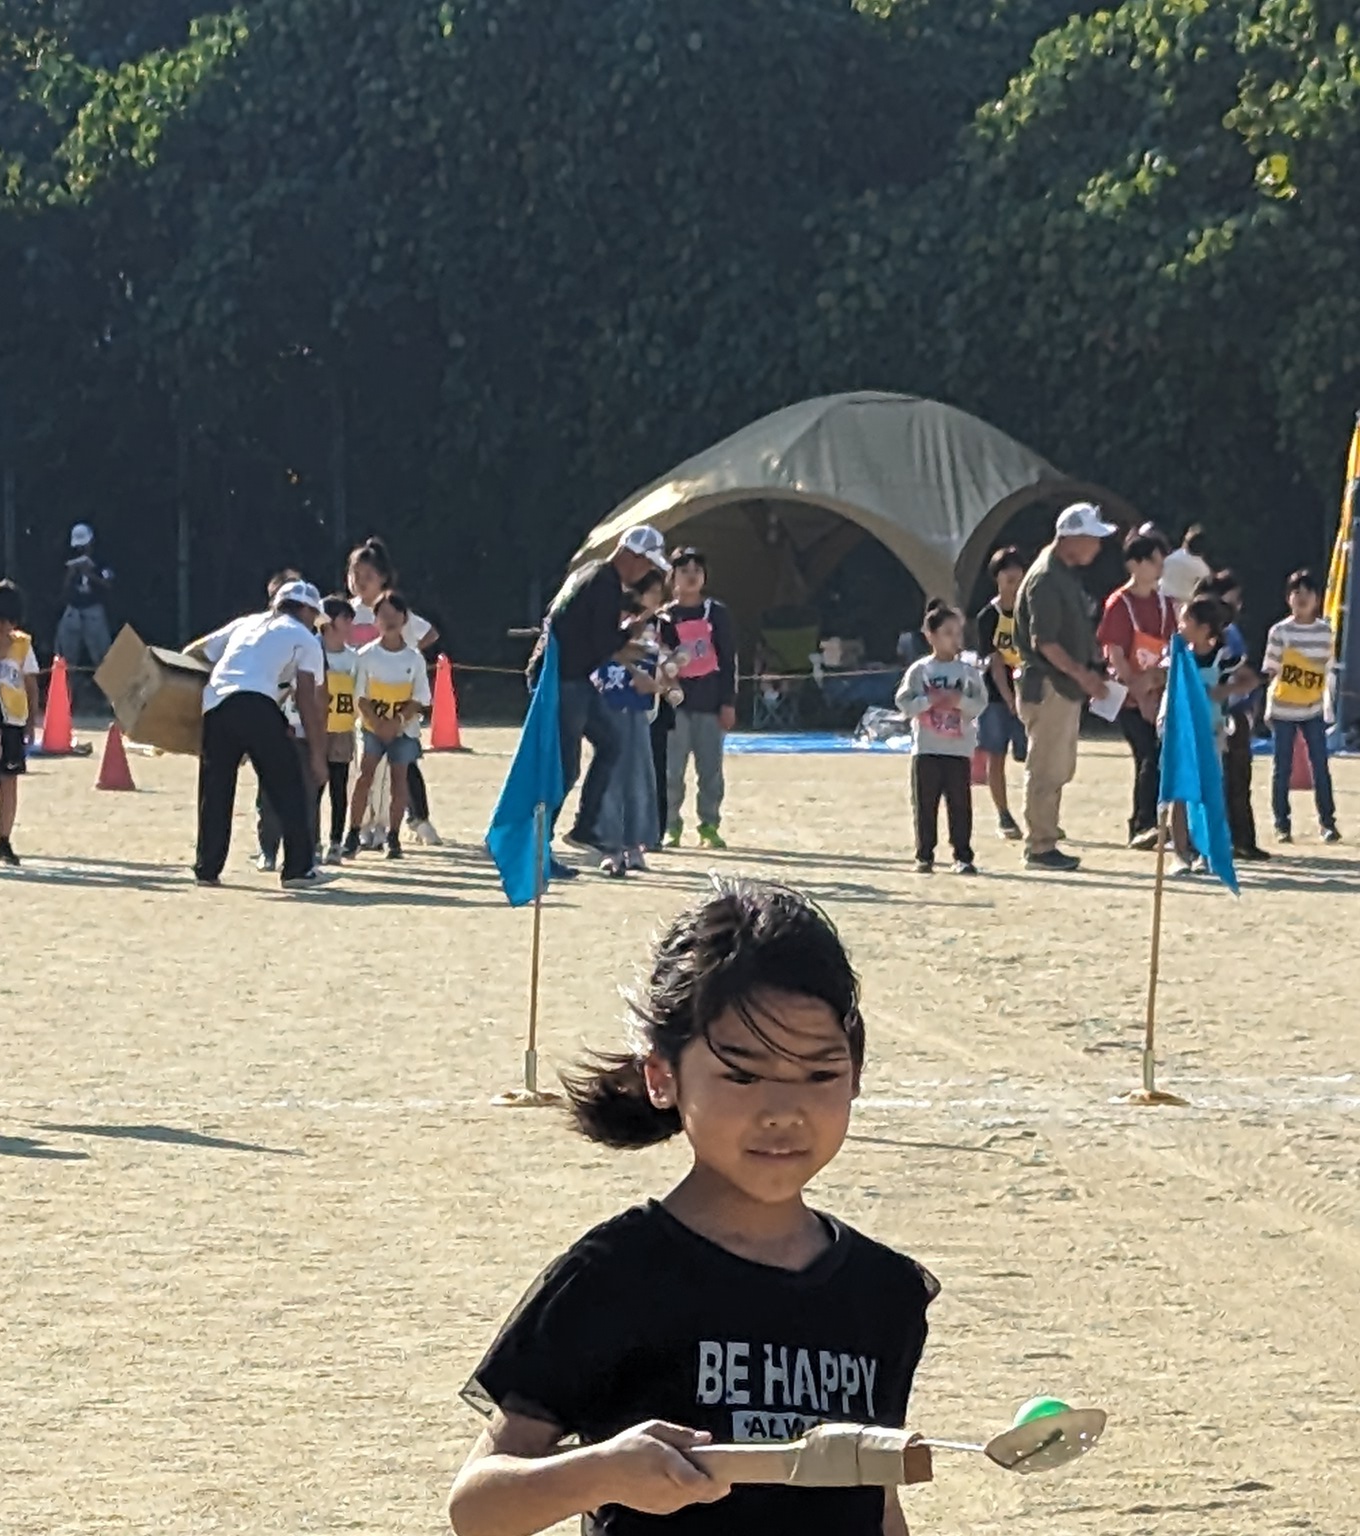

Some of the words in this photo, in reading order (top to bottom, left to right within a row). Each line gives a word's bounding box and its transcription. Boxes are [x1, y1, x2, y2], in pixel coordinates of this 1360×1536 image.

[327, 693, 355, 715] 田
[696, 1340, 751, 1405] BE
[763, 1343, 877, 1419] HAPPY
